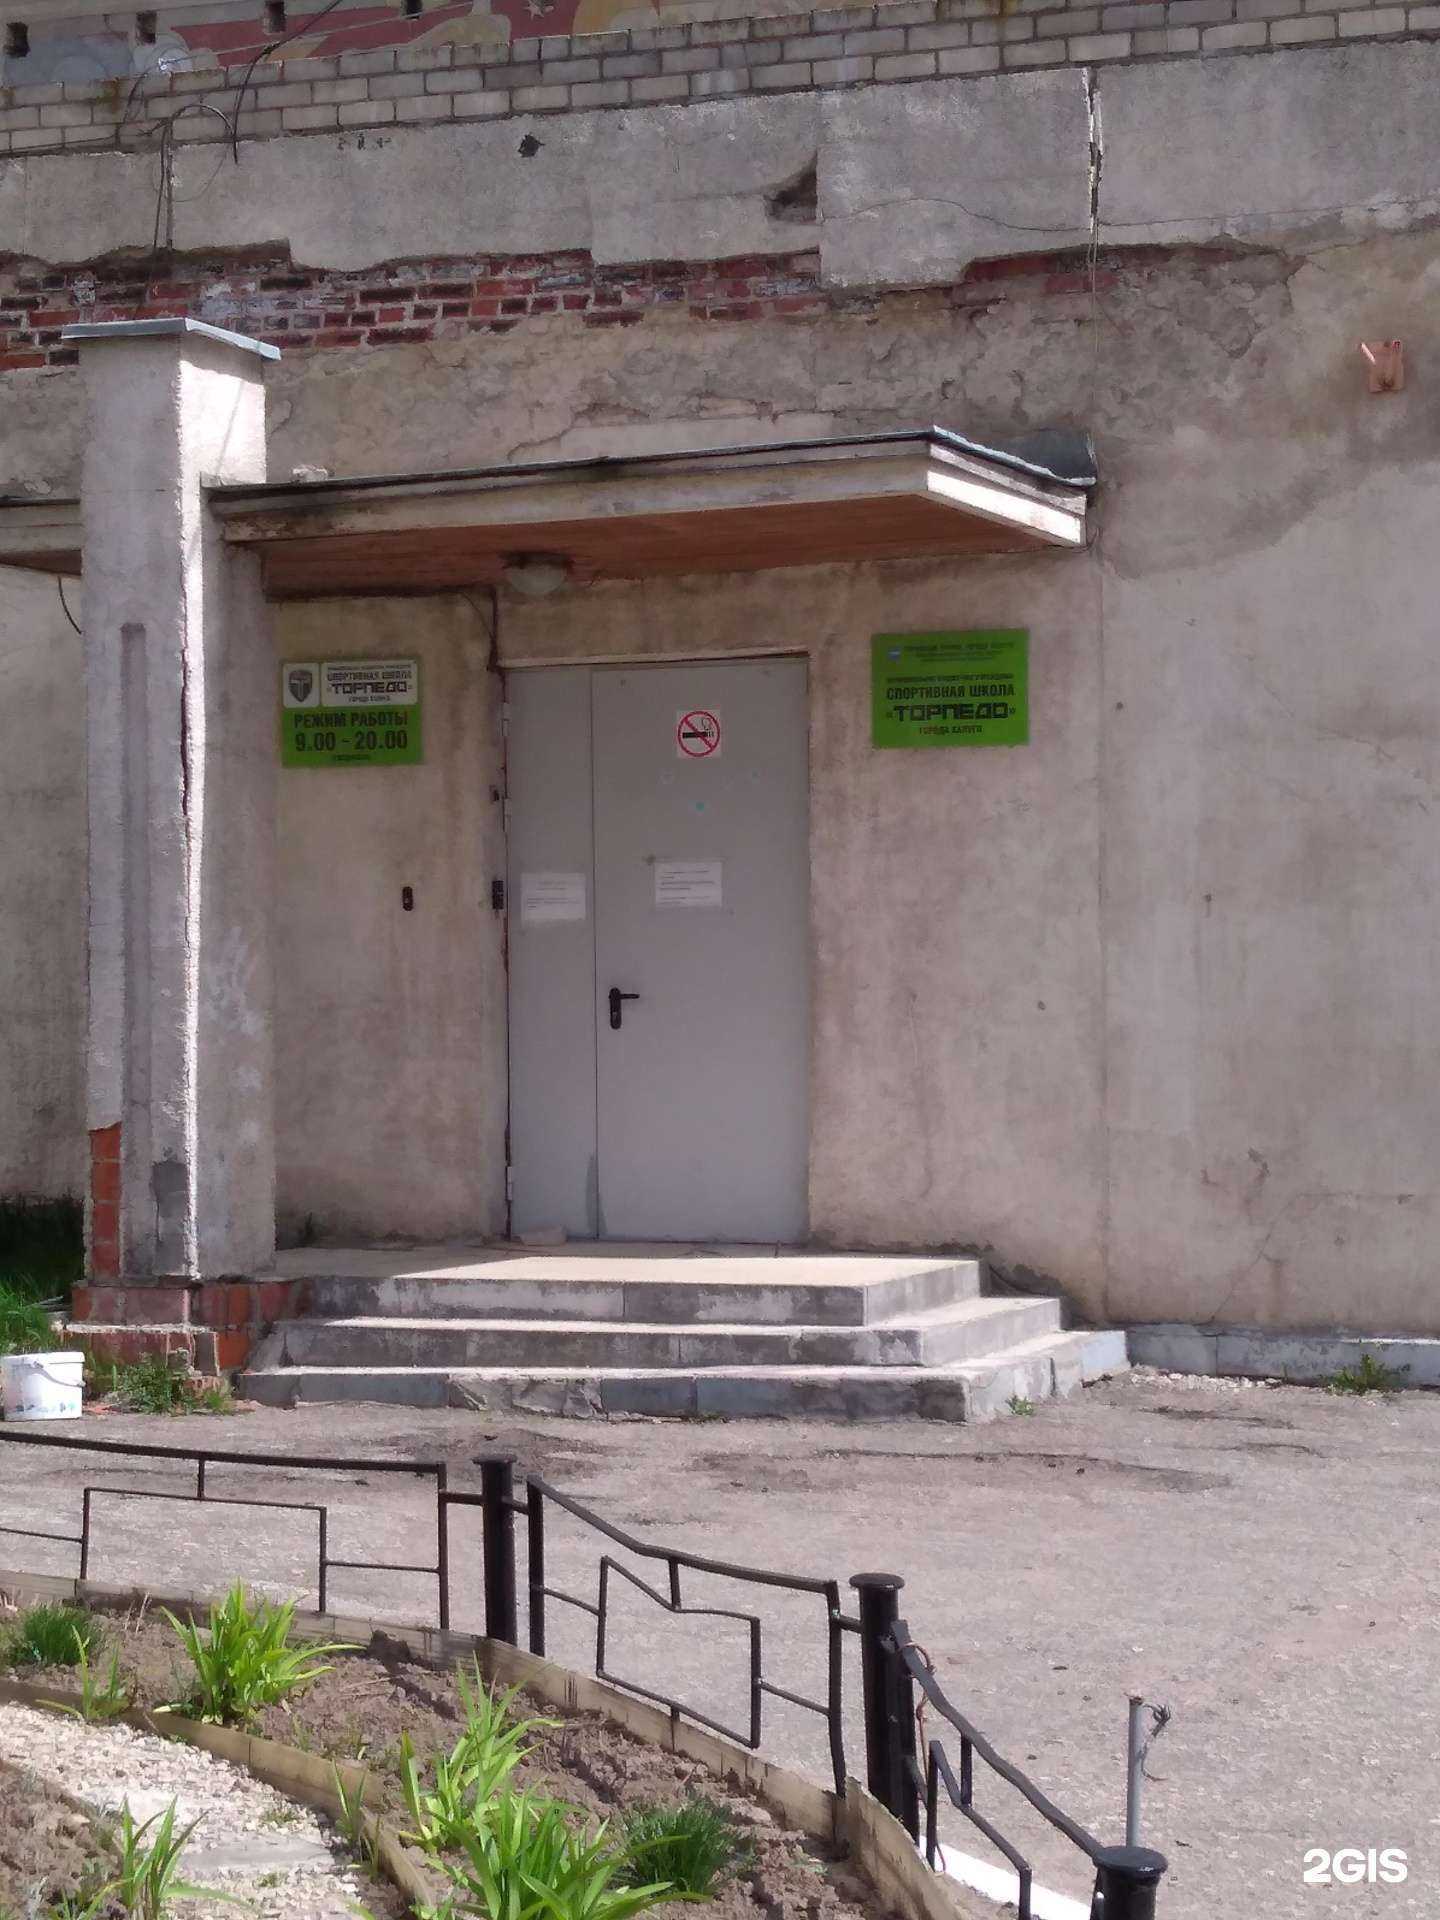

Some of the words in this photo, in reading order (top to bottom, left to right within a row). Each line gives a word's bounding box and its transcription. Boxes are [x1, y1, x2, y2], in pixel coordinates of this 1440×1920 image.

[887, 685, 965, 700] СПОРТИВНАЯ
[969, 683, 1015, 697] ШКОЛА
[294, 712, 346, 728] РЕЖИМ
[351, 711, 408, 727] РАБОТЫ
[295, 731, 336, 751] 9.00
[354, 730, 408, 750] 20.00
